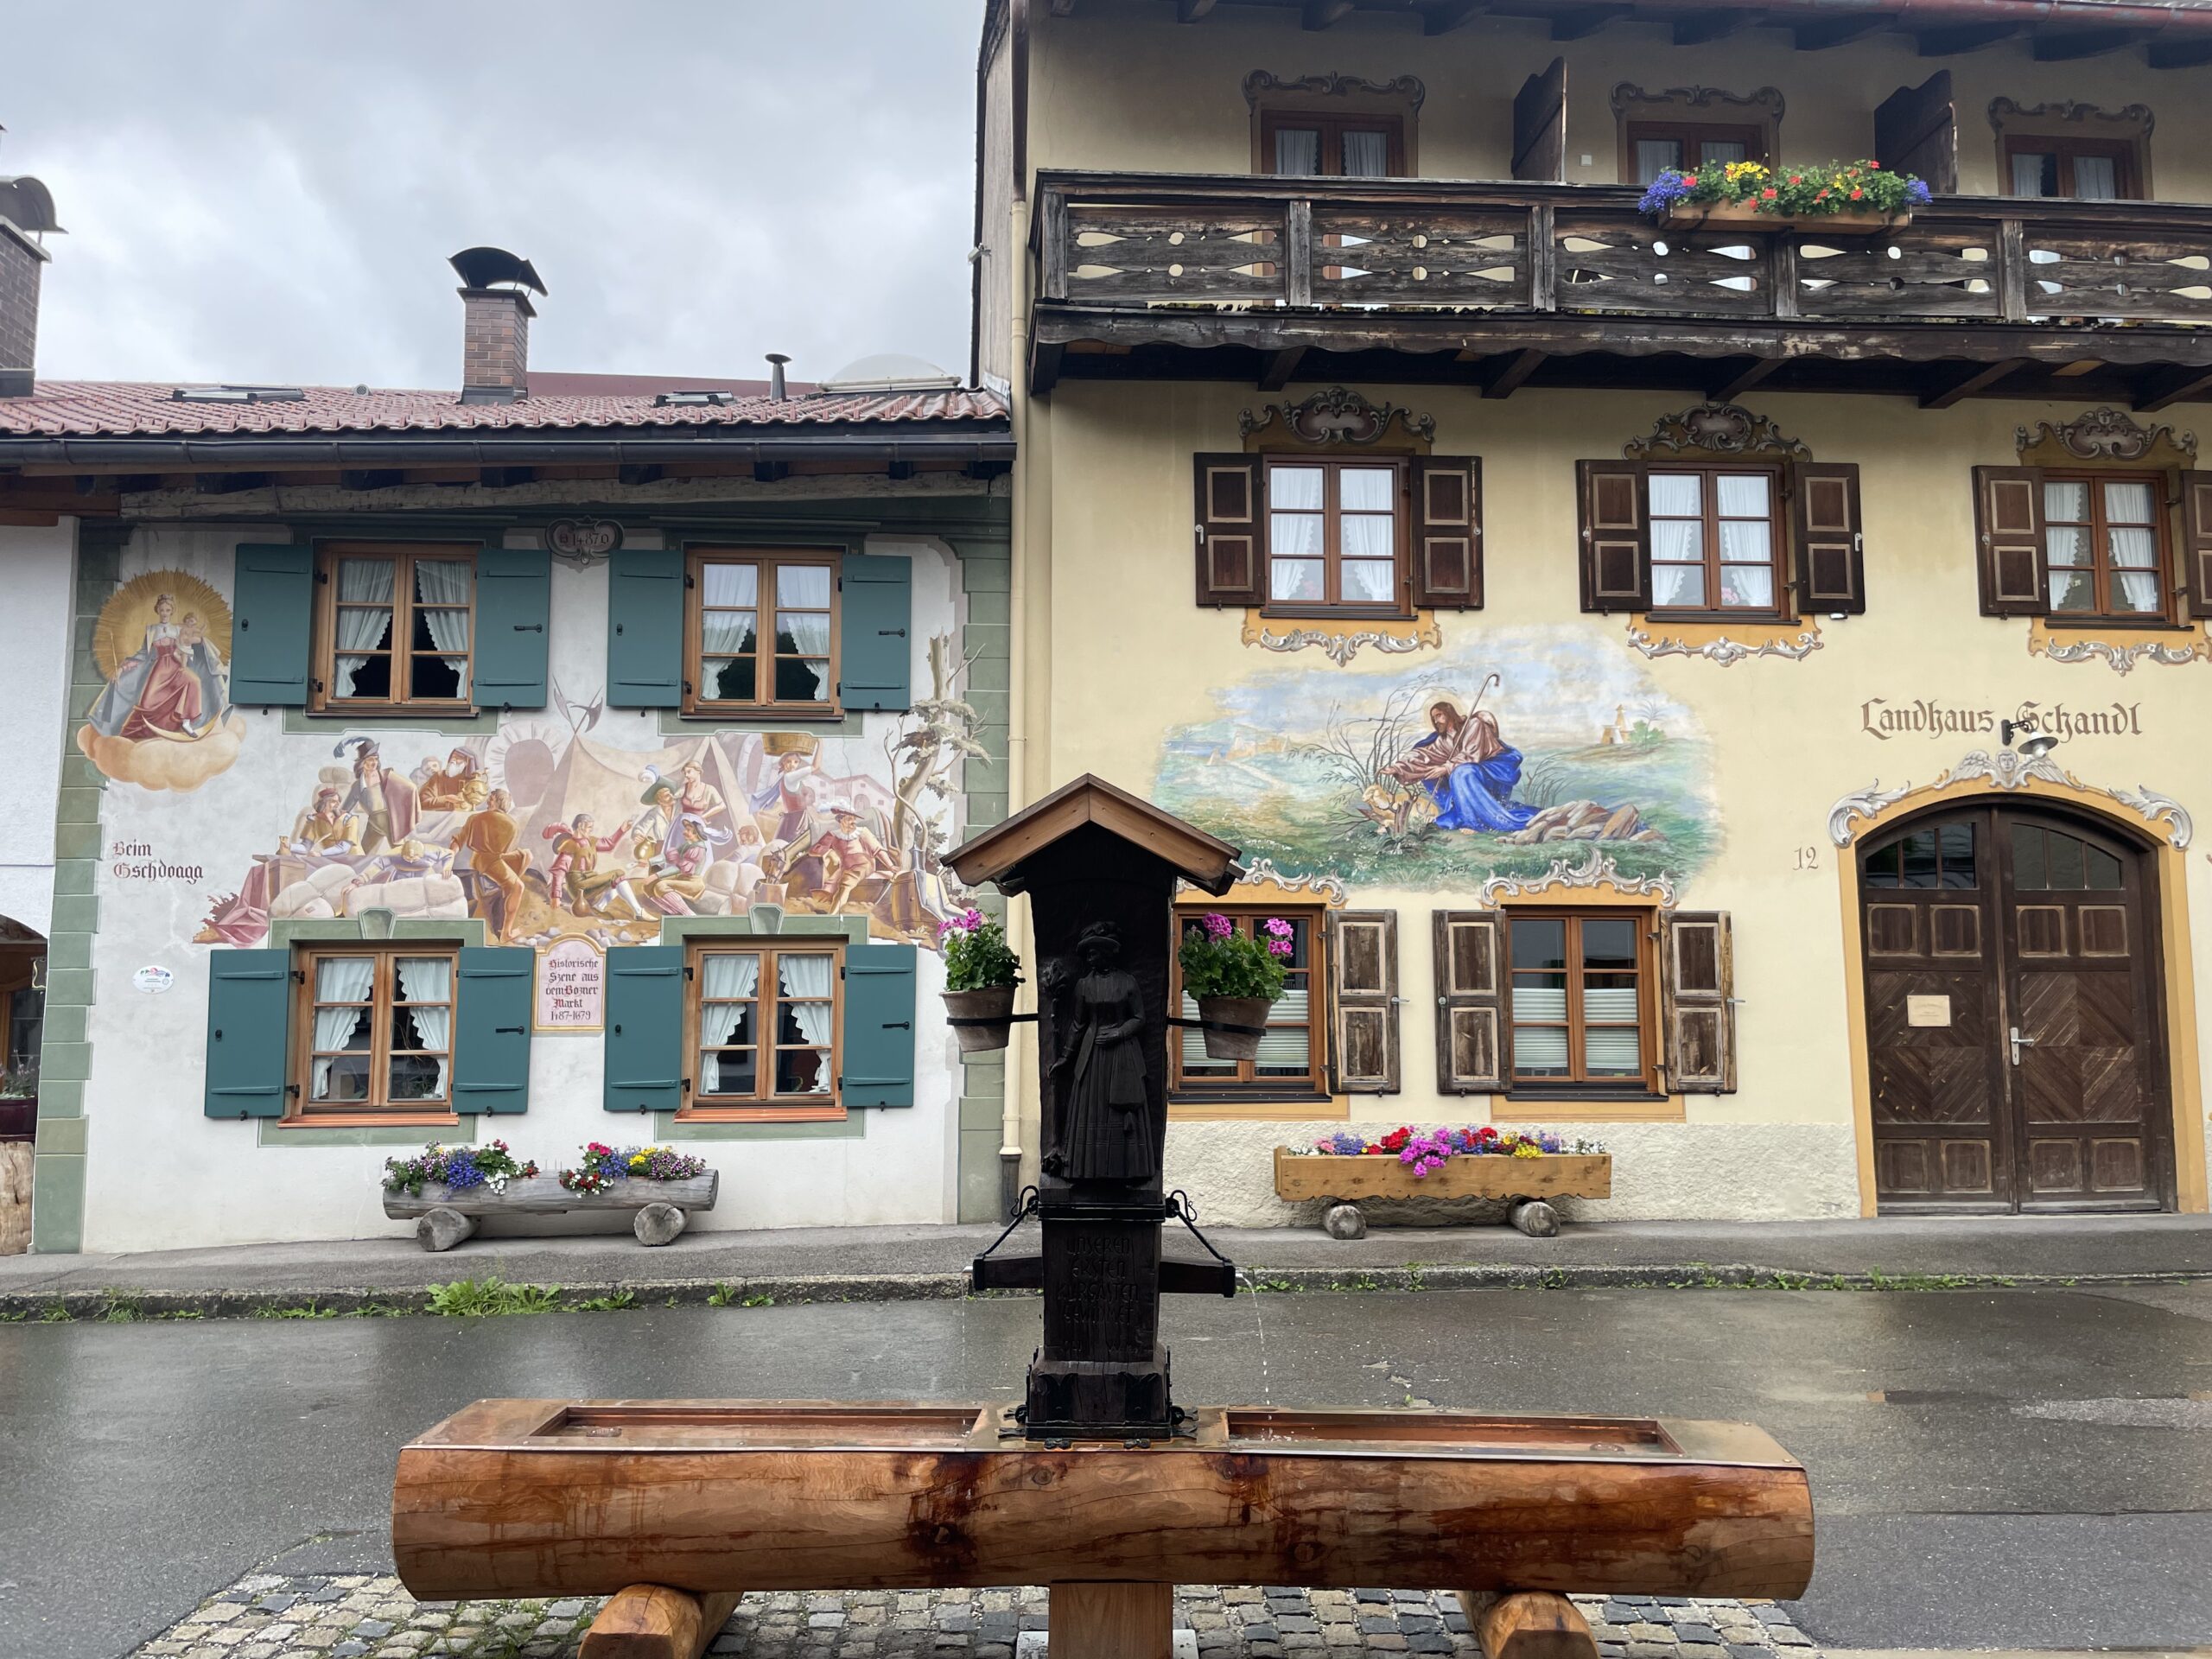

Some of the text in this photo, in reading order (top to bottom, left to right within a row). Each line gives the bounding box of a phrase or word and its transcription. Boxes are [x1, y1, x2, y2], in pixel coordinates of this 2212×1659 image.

[573, 532, 599, 545] 1487
[1860, 697, 2143, 744] Landhaus Schandl
[112, 839, 152, 859] Beim
[1792, 846, 1819, 871] 12
[113, 860, 204, 885] Gschdoaga
[548, 958, 599, 970] Historische
[549, 972, 599, 983] Szene aus
[545, 983, 599, 996] dem Bozner
[553, 998, 583, 1009] Markt
